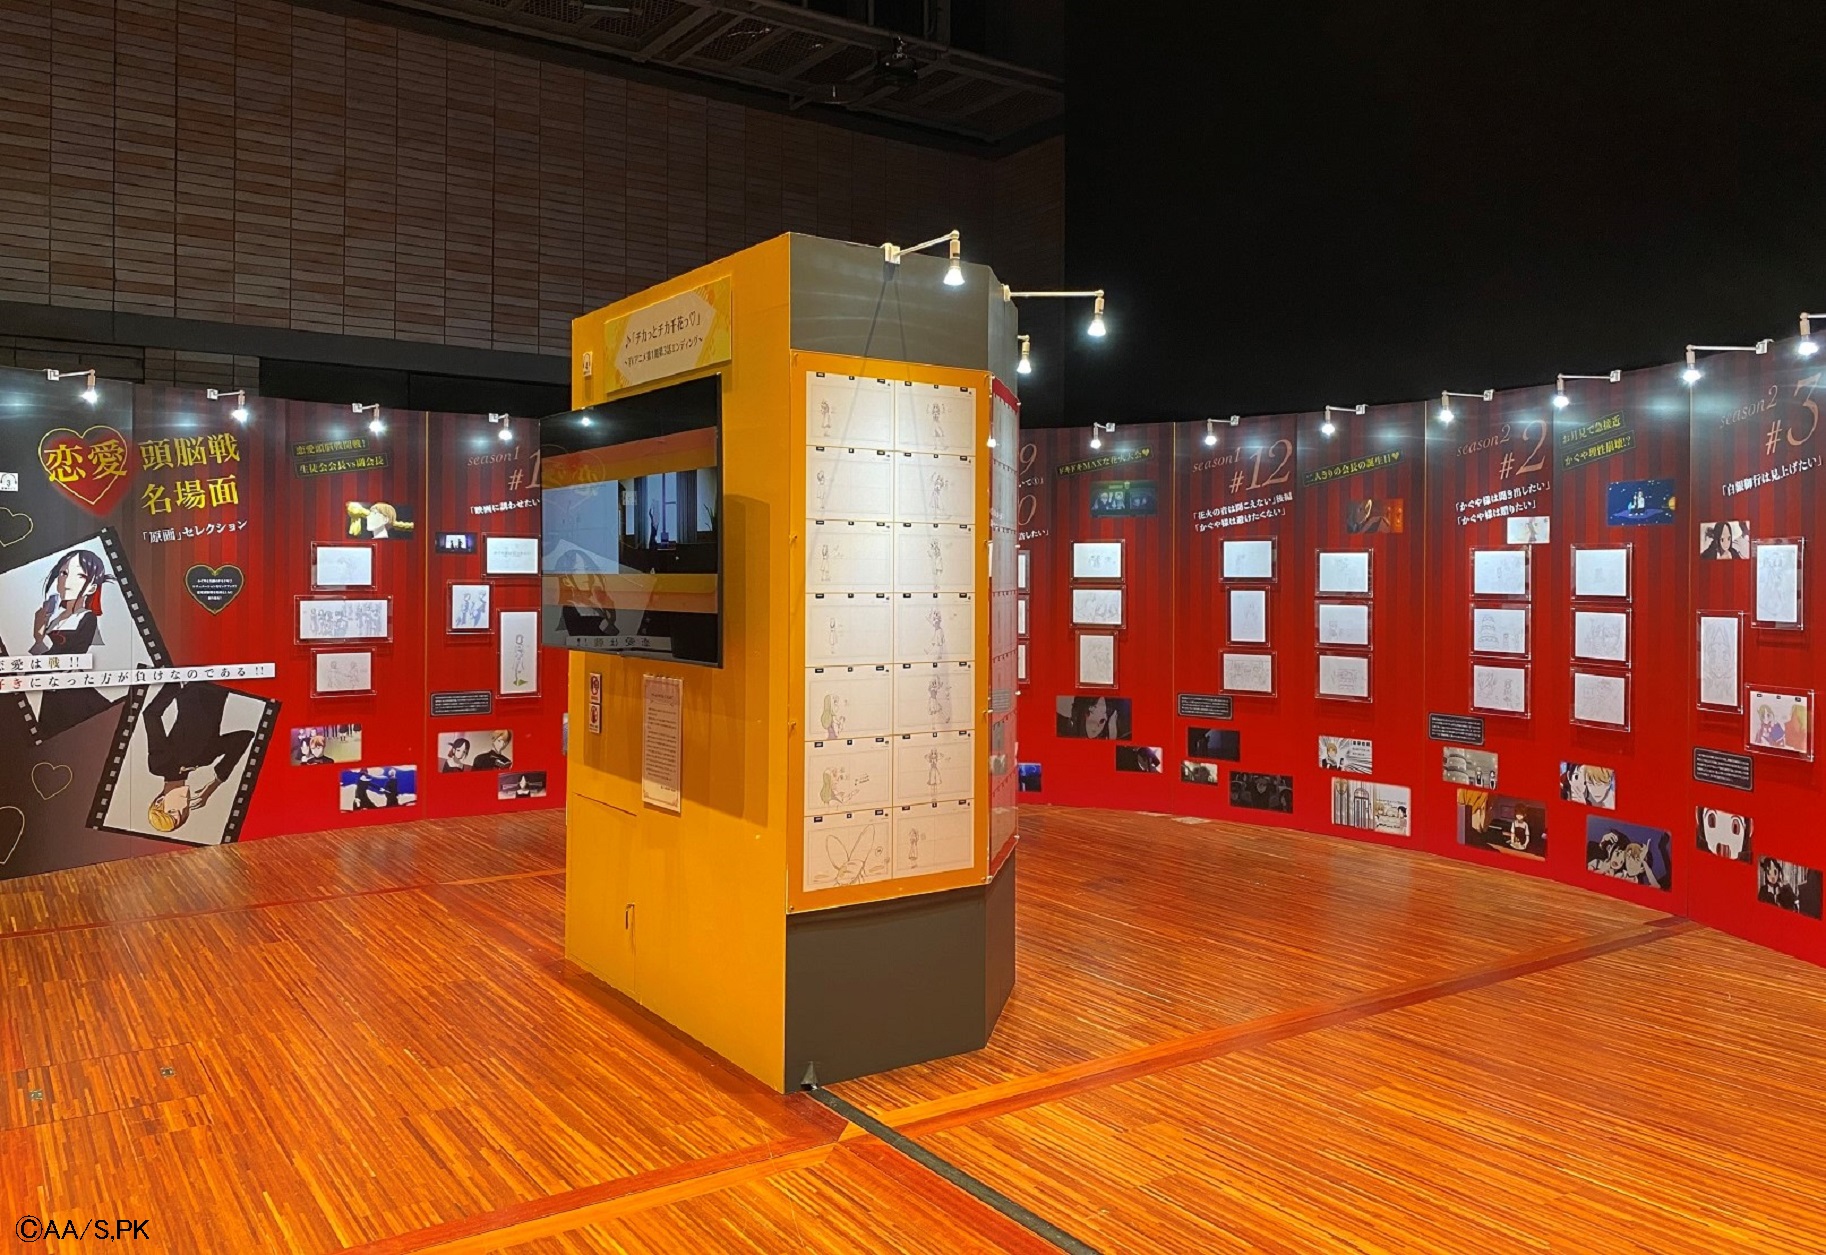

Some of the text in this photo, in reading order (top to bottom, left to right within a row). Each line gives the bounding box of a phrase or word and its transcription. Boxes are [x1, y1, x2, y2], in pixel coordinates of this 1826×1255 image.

[1719, 384, 1778, 429] season2
[1765, 372, 1822, 455] #3
[467, 445, 520, 466] season1
[1192, 447, 1241, 473] season1
[1457, 423, 1511, 457] season2
[1499, 420, 1547, 480] #2
[1229, 439, 1293, 493] #12
[141, 474, 239, 515] 名場面
[142, 520, 247, 544] 「原画」セレクション
